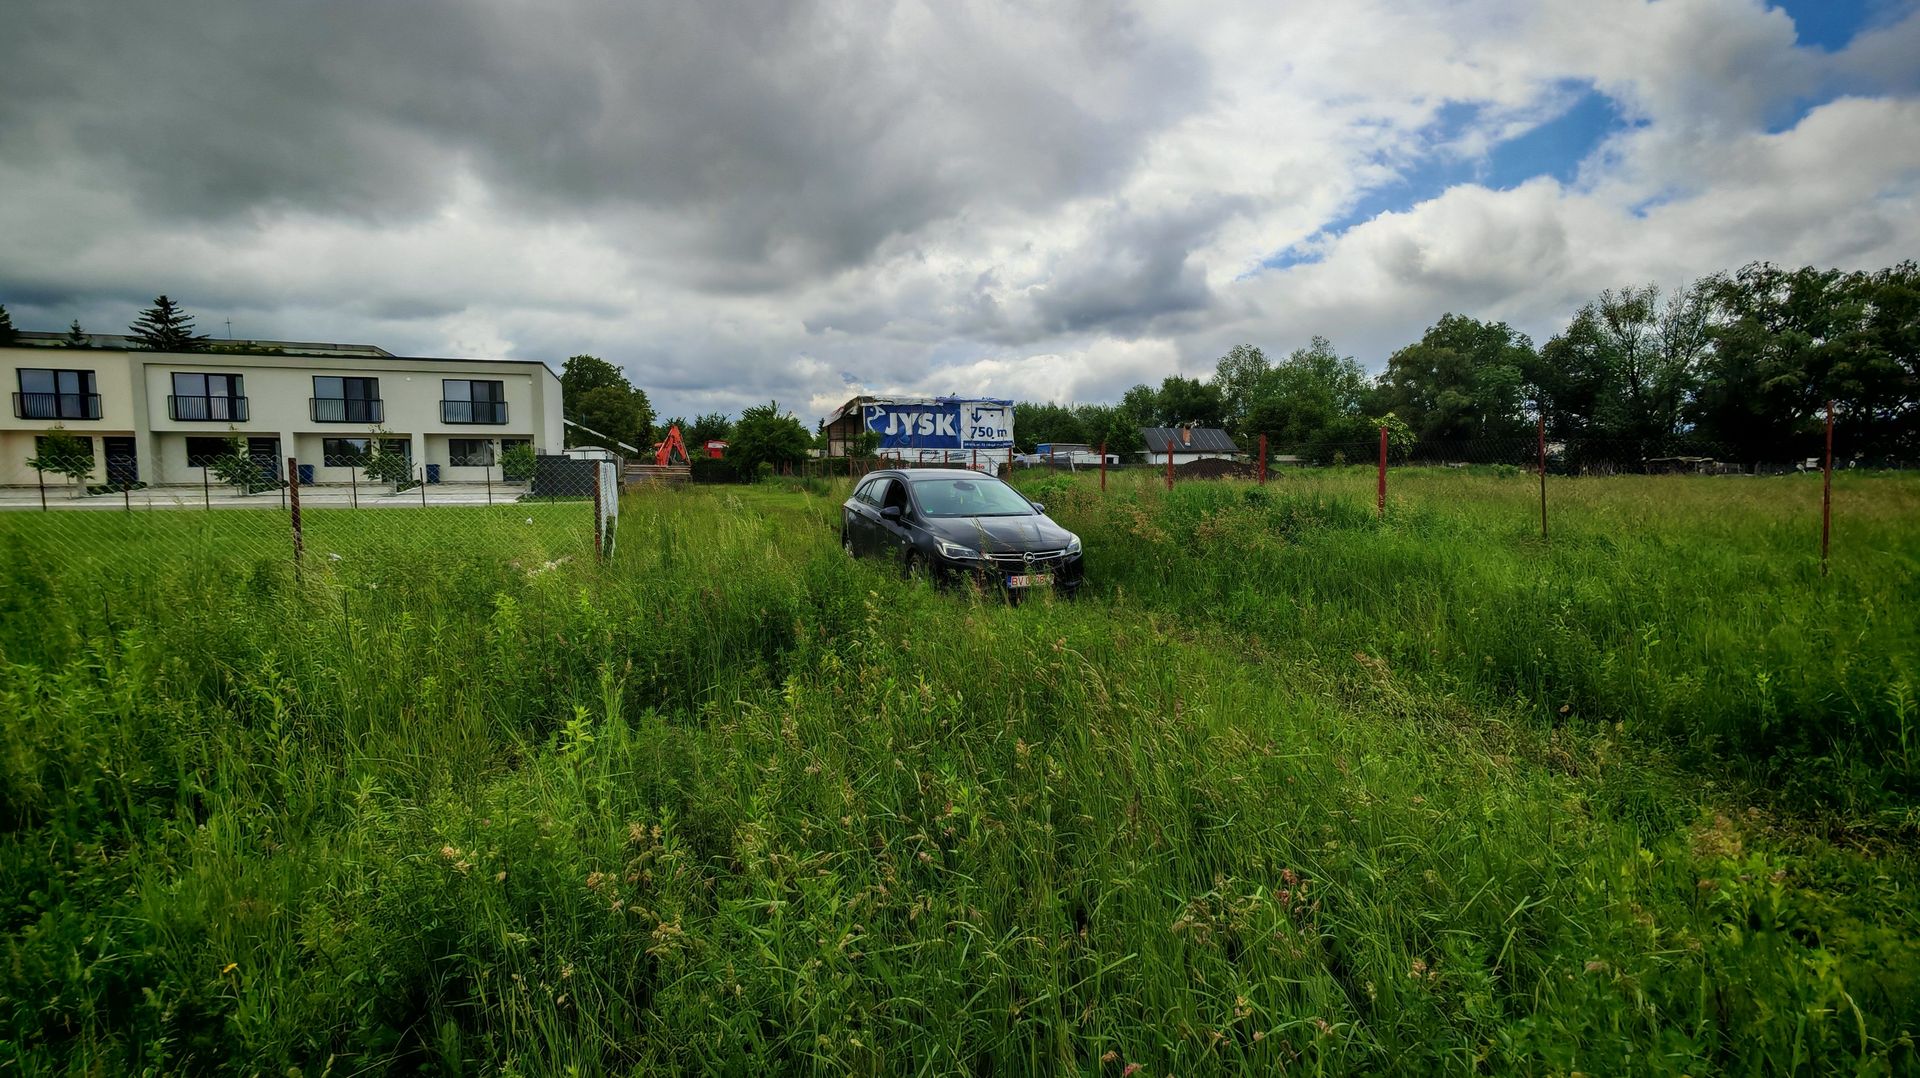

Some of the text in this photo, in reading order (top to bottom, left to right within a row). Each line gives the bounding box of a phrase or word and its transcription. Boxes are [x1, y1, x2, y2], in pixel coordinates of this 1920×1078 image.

[885, 412, 957, 436] JYSK
[970, 426, 1007, 438] 750 m
